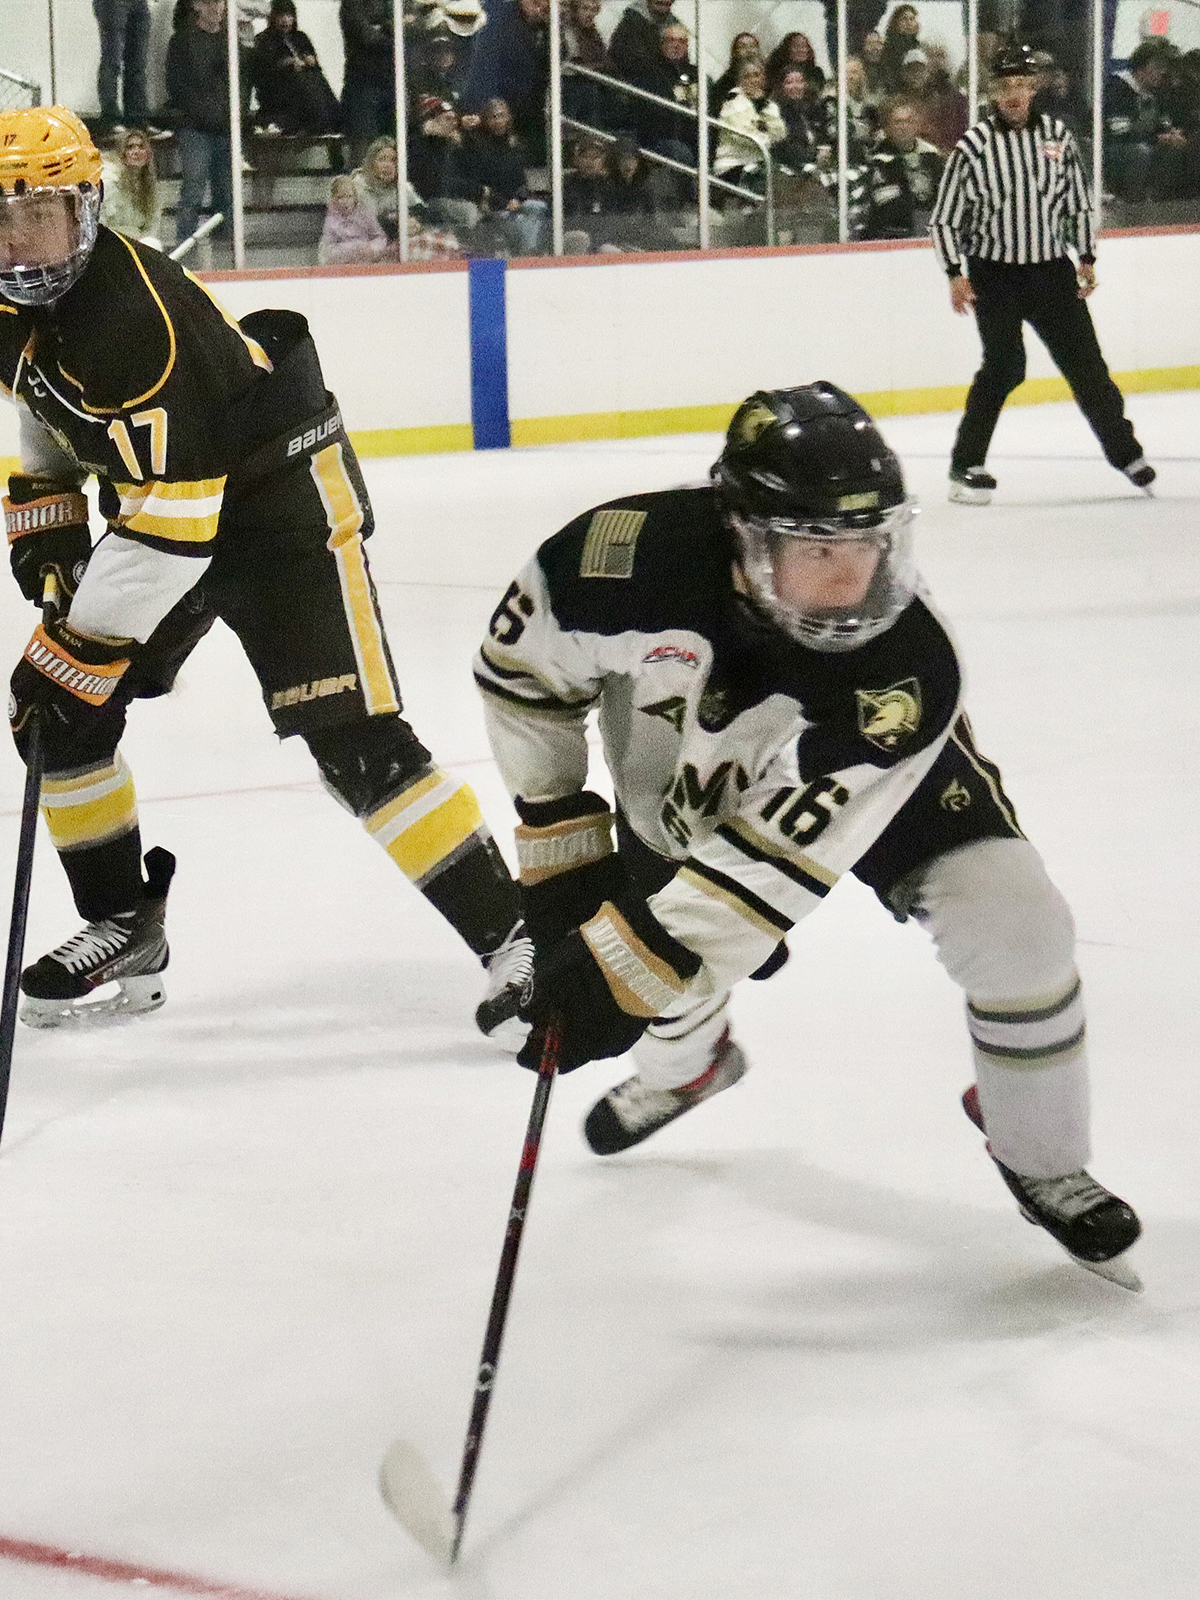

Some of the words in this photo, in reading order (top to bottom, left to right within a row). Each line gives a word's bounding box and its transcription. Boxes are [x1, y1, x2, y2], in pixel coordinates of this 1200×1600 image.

[3, 132, 17, 147] 17
[107, 407, 168, 481] 17
[760, 776, 850, 846] 16
